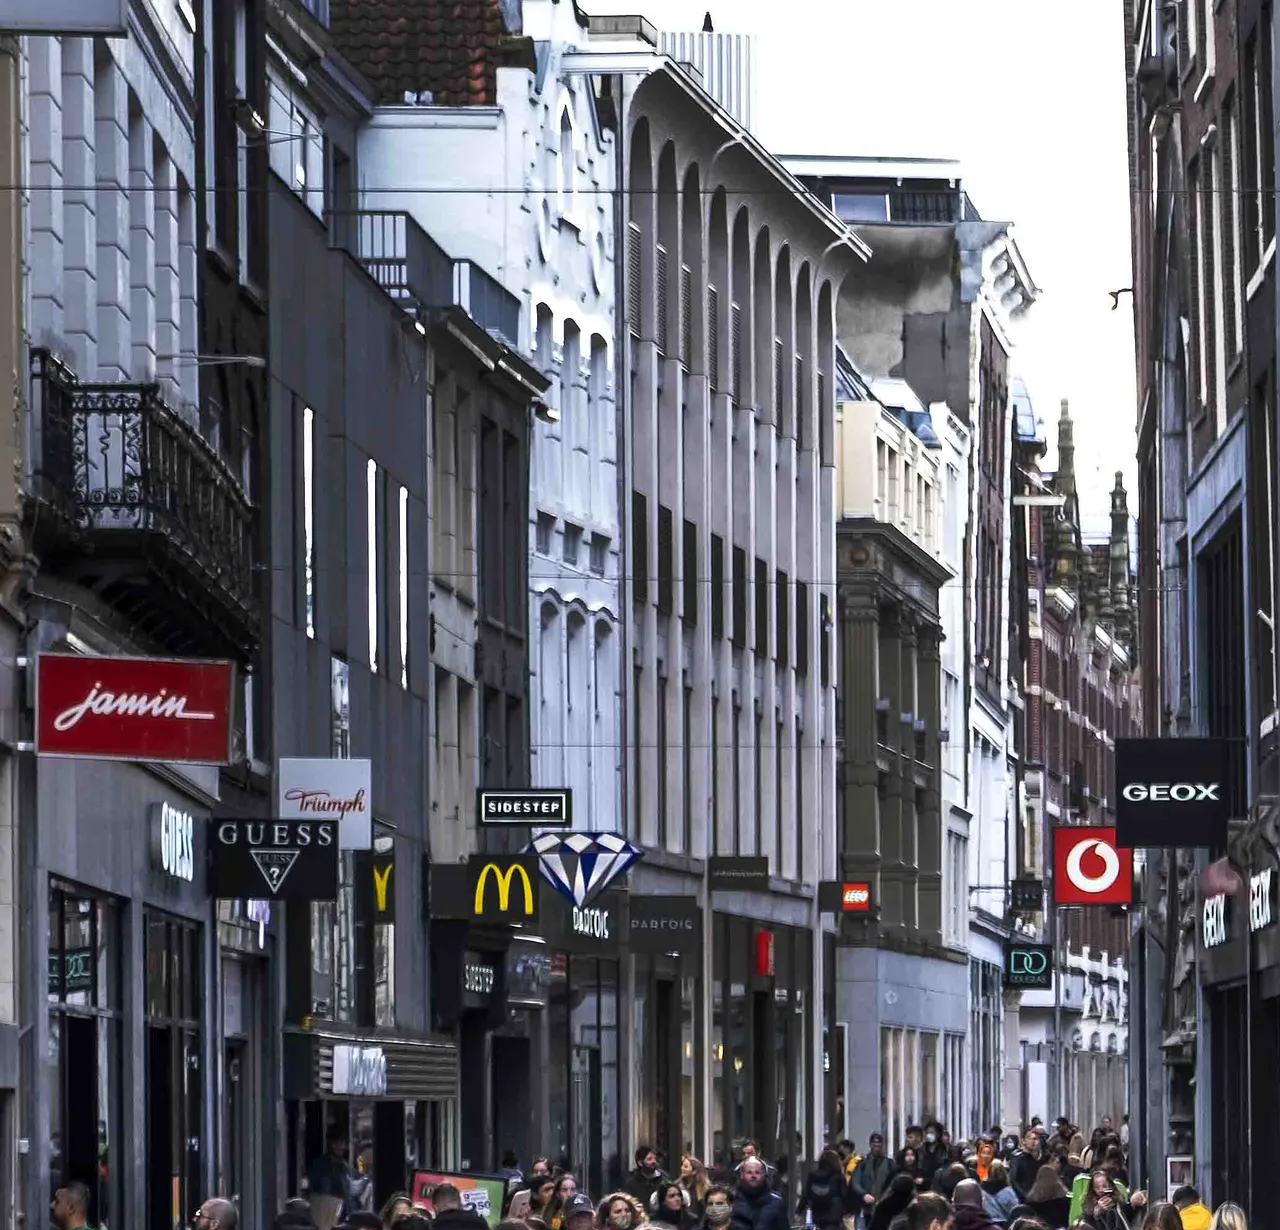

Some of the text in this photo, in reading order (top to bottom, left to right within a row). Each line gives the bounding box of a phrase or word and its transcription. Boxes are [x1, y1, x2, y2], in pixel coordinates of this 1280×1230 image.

[54, 681, 215, 732] jamin
[285, 787, 366, 820] Triumph
[487, 801, 561, 814] SIDESTEP
[1122, 782, 1219, 801] GEOX
[160, 800, 194, 883] GUESS
[218, 823, 333, 846] GUESS
[844, 889, 870, 904] LEGO
[1249, 867, 1271, 932] GEOX
[1203, 893, 1226, 949] GEOX
